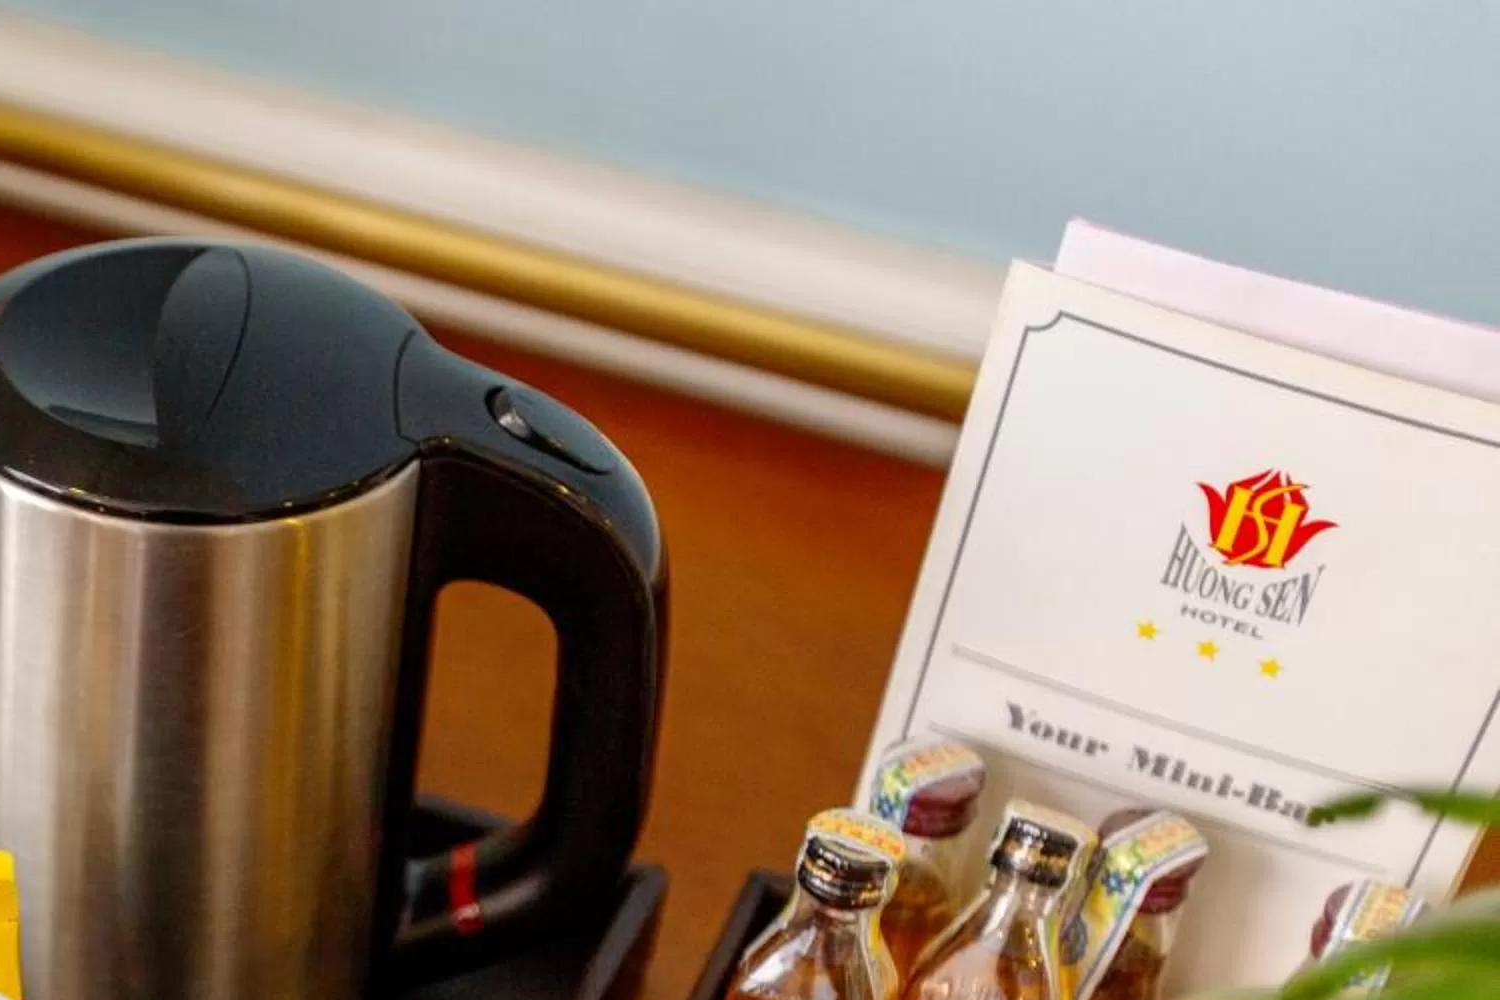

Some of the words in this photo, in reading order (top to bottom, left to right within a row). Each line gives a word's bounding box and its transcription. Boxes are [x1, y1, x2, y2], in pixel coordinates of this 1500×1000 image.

[1179, 602, 1264, 641] HOTEL
[1254, 563, 1327, 628] SEN
[1005, 699, 1110, 757] Your
[1127, 744, 1310, 822] Mini-Ba
